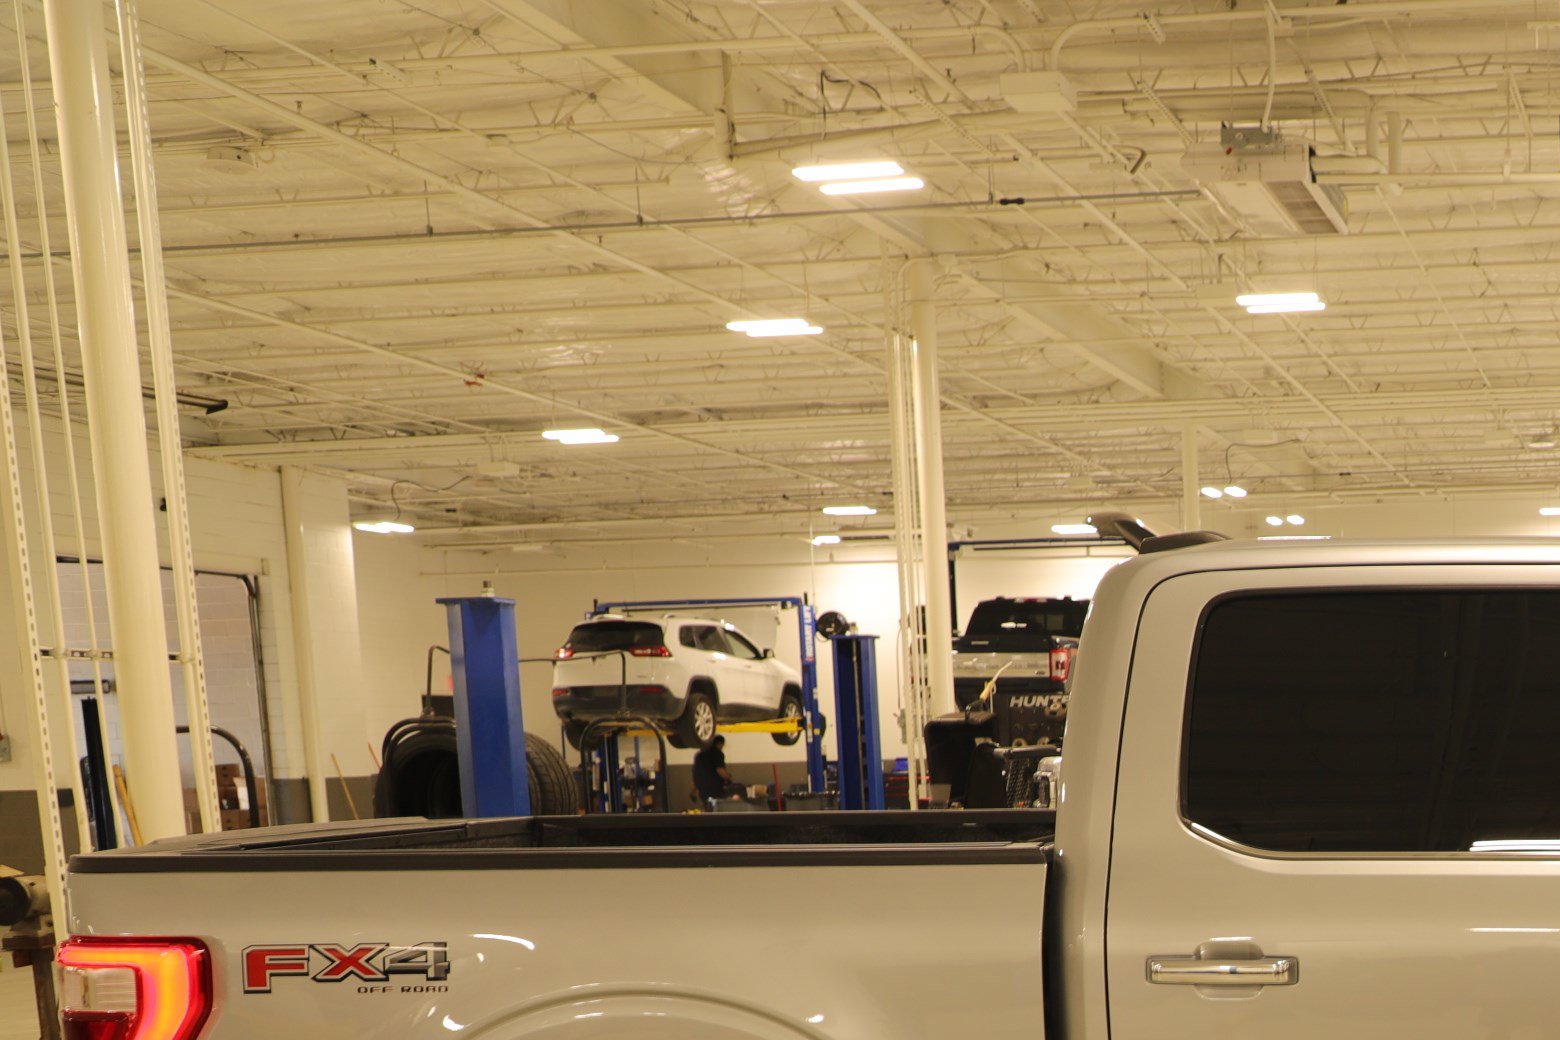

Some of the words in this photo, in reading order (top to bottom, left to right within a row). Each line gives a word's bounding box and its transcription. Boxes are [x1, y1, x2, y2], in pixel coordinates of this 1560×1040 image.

[242, 942, 450, 994] FX4
[357, 985, 394, 994] OFF
[401, 985, 448, 994] ROAD
